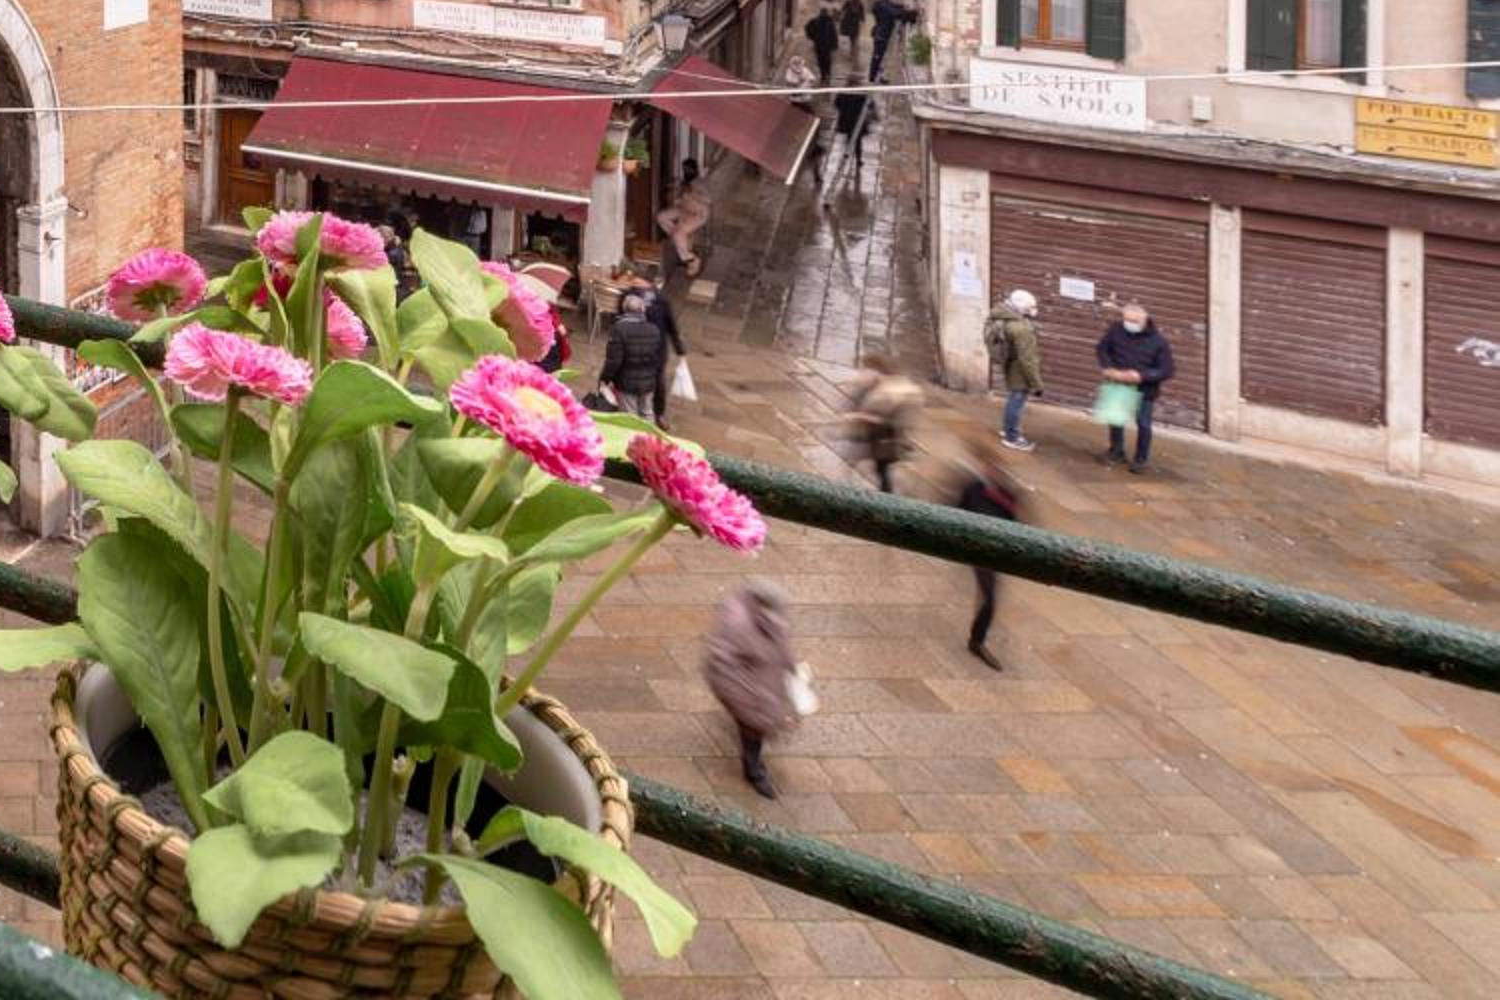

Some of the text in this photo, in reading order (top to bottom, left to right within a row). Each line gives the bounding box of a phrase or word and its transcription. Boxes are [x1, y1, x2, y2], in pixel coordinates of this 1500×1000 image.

[1002, 71, 1113, 95] SESTIER
[982, 85, 1013, 103] DE
[1366, 102, 1489, 123] PER RIALTO
